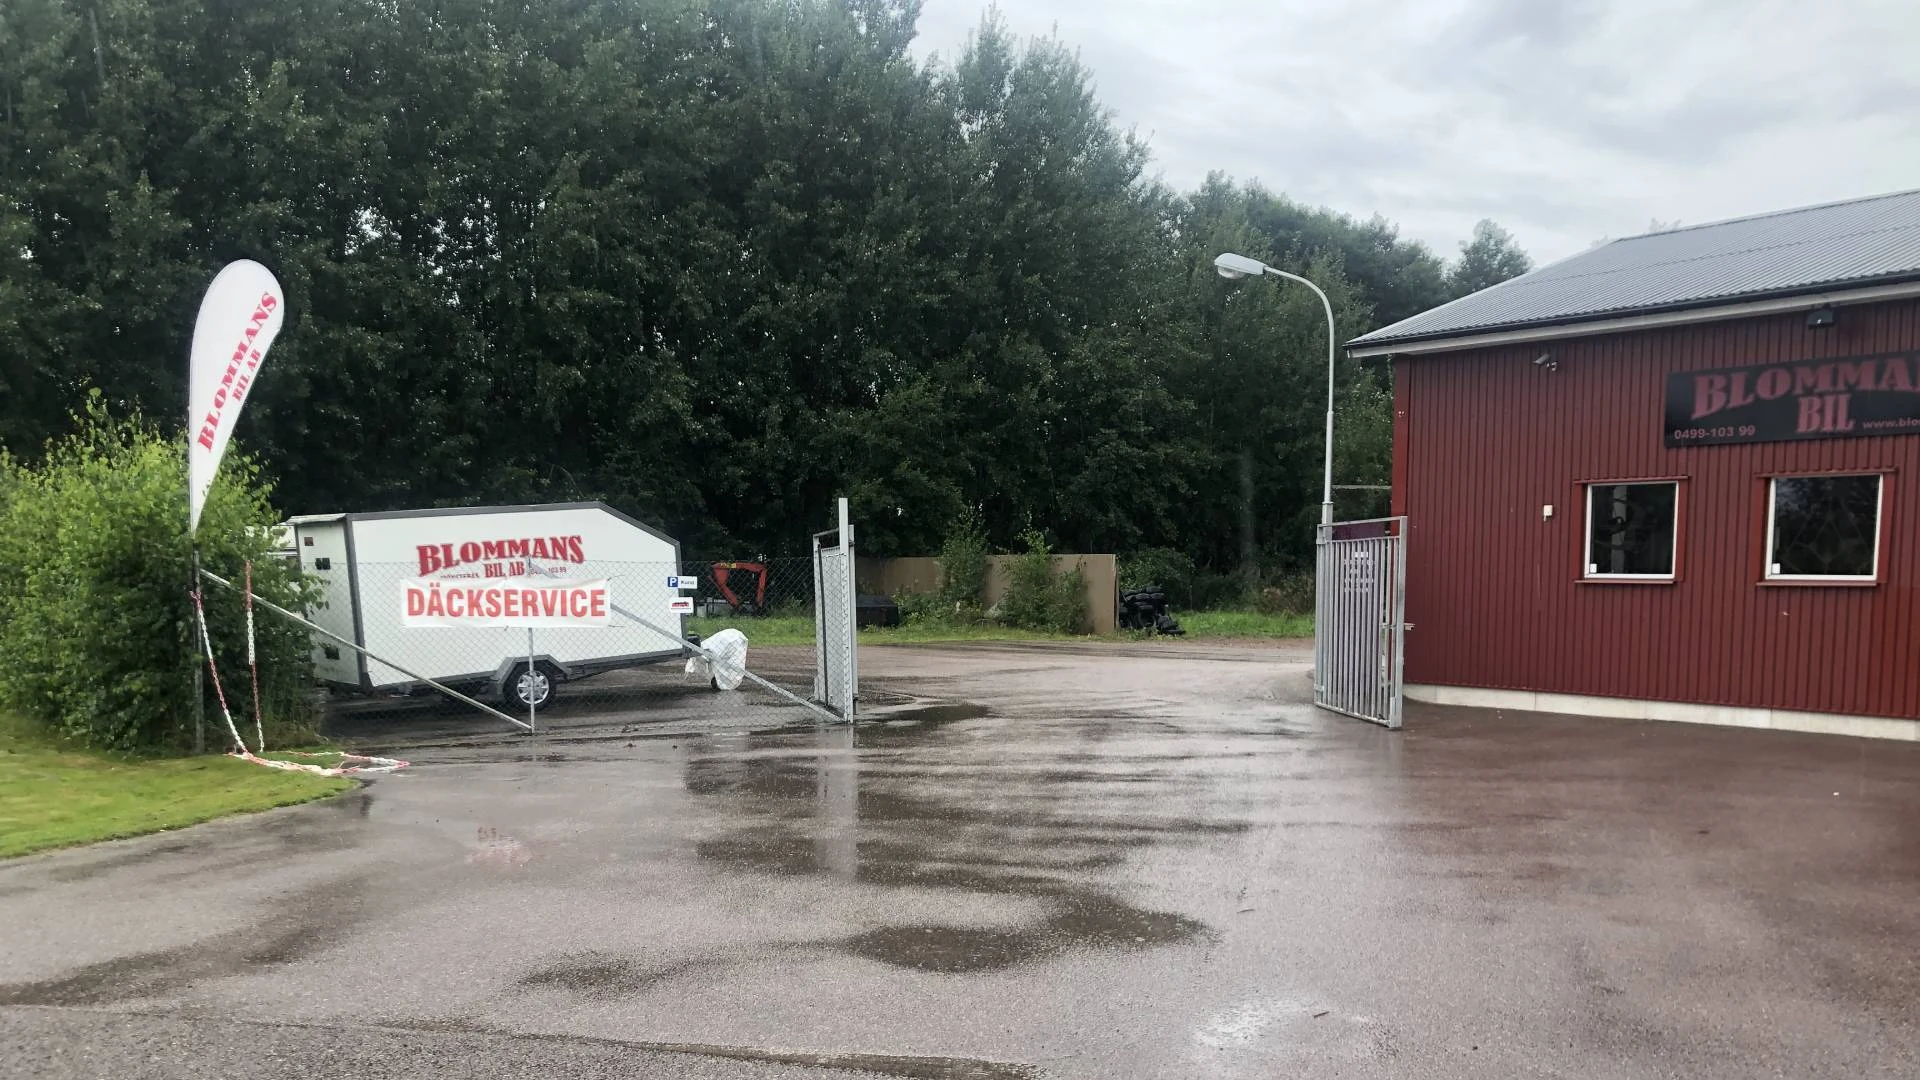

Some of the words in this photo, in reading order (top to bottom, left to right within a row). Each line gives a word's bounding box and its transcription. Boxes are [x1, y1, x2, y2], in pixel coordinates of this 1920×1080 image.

[198, 291, 278, 453] BLOMMANS
[232, 374, 250, 401] BIL
[246, 349, 261, 372] AB
[1691, 358, 1920, 420] BLOMMA
[1674, 427, 1734, 440] 0499-103
[1739, 425, 1754, 437] 99
[1796, 394, 1856, 433] BIL
[1863, 417, 1920, 429] www.blo
[416, 535, 585, 577] BLOMMANS
[483, 563, 507, 578] BIL
[509, 561, 525, 577] AB
[407, 582, 606, 617] DÄCKSERVICE
